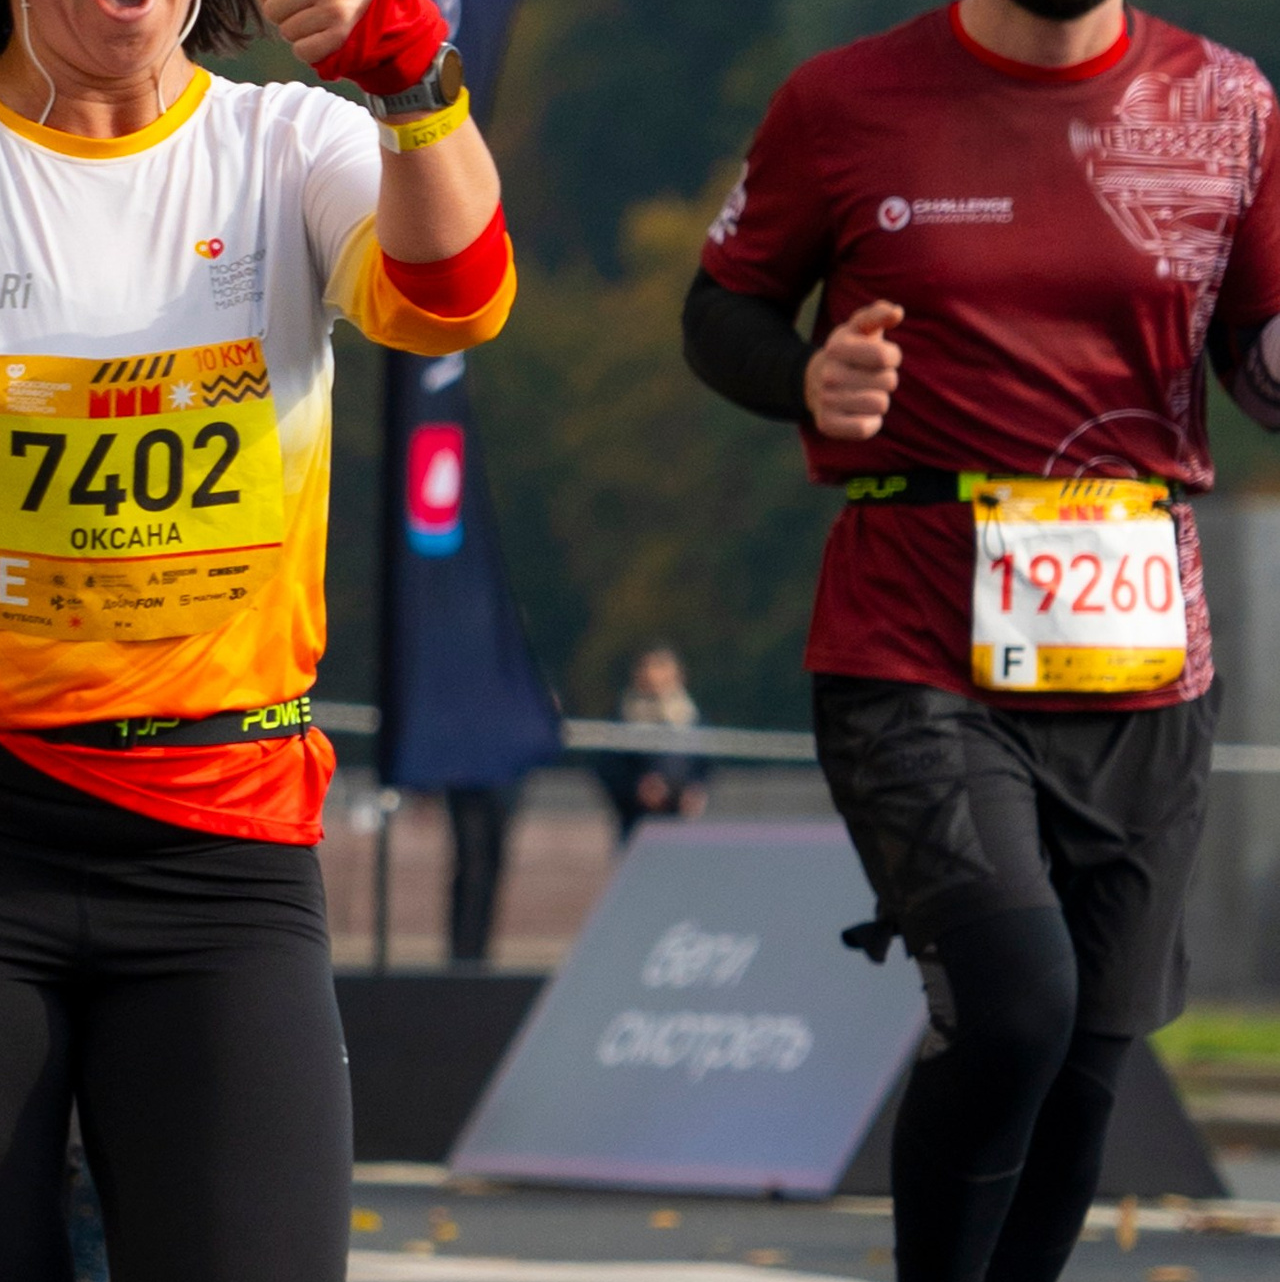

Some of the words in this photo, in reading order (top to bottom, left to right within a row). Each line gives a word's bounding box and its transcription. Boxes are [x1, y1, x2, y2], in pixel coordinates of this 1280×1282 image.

[193, 348, 217, 373] 10
[10, 421, 241, 517] 7402
[70, 522, 183, 551] ОКСАНА
[990, 553, 1175, 613] 19260
[1004, 646, 1025, 677] F
